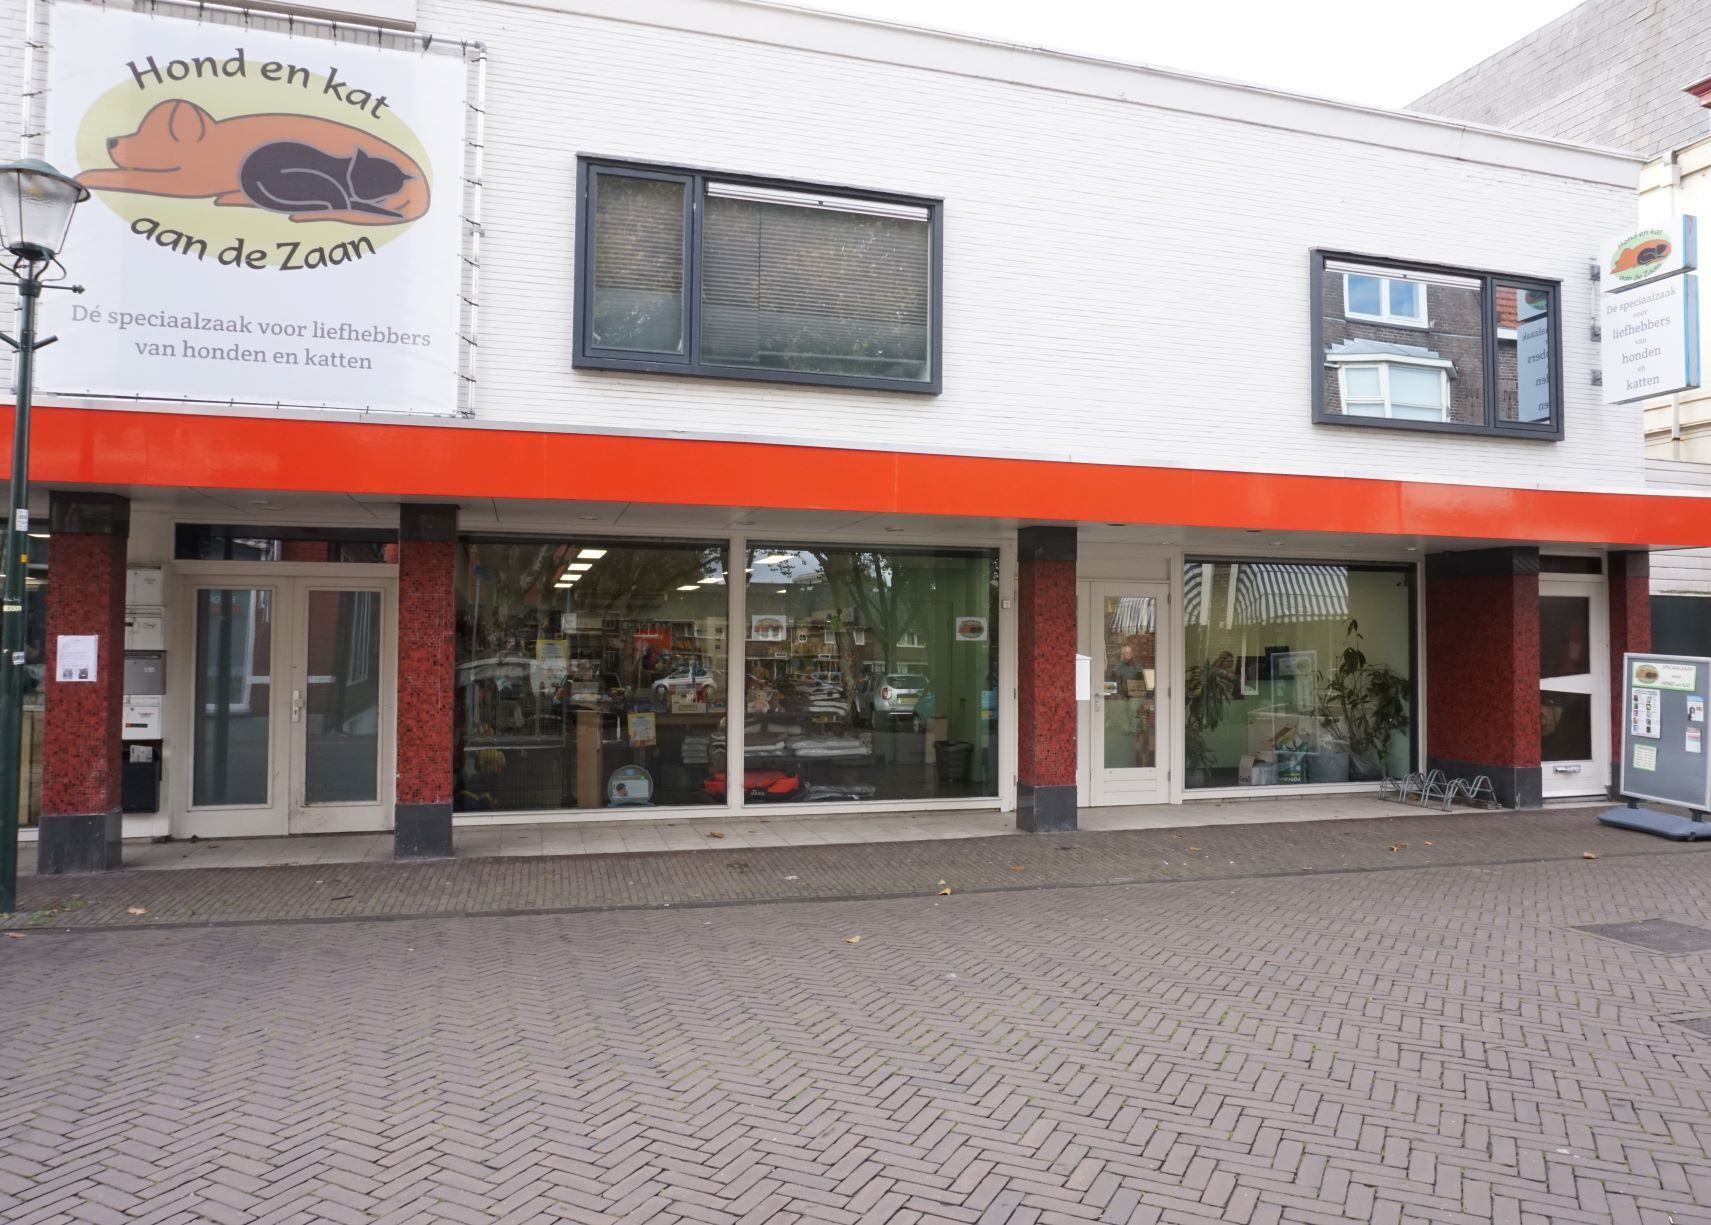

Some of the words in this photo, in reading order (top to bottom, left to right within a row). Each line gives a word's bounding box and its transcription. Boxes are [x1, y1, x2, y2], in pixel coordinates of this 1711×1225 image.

[125, 47, 246, 90] Hond
[260, 60, 310, 89] en
[322, 66, 390, 120] kat
[130, 217, 208, 261] aan
[217, 238, 267, 270] de
[276, 236, 376, 271] Zaan
[1620, 286, 1677, 312] speciaalzaak
[71, 304, 101, 322] Dé
[108, 310, 253, 334] speciaalzaak
[258, 320, 307, 338] voor
[312, 320, 431, 347] liefhebbers
[1612, 316, 1671, 339] liefhebbers
[135, 340, 176, 357] van
[182, 340, 267, 364] honden
[273, 351, 299, 365] en
[304, 348, 373, 370] katten
[1622, 347, 1661, 364] honden
[1626, 376, 1660, 390] katten
